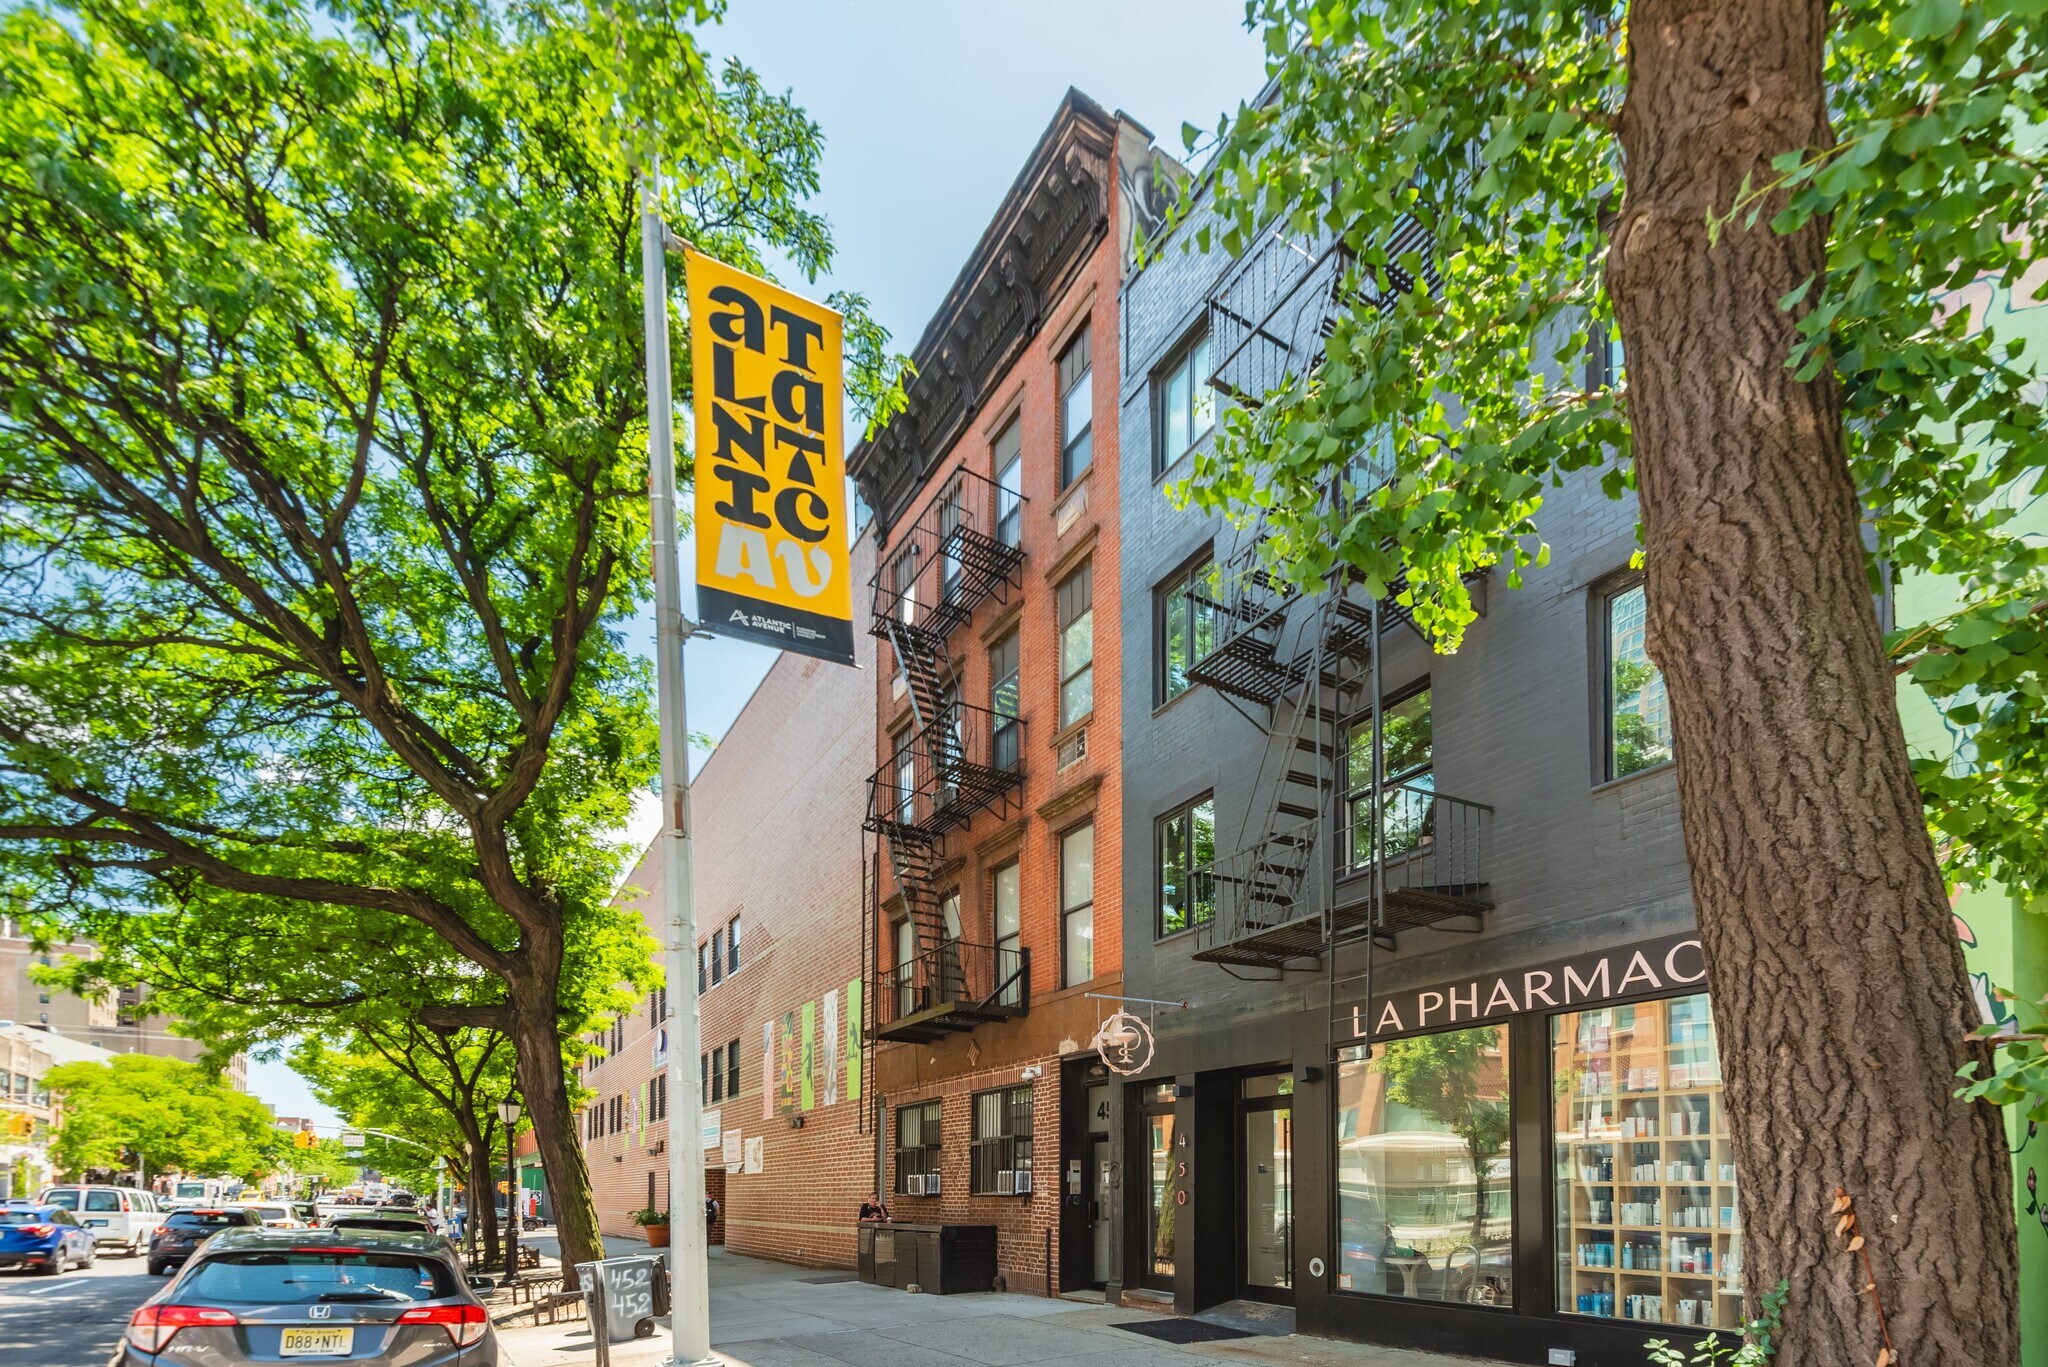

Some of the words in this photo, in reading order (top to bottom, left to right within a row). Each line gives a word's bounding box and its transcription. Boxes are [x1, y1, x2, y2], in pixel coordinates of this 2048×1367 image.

[751, 615, 792, 630] ATLANTIC
[751, 621, 785, 634] AVENUE
[1353, 1000, 1404, 1038] LA
[611, 1268, 650, 1289] 452
[612, 1292, 651, 1317] 452
